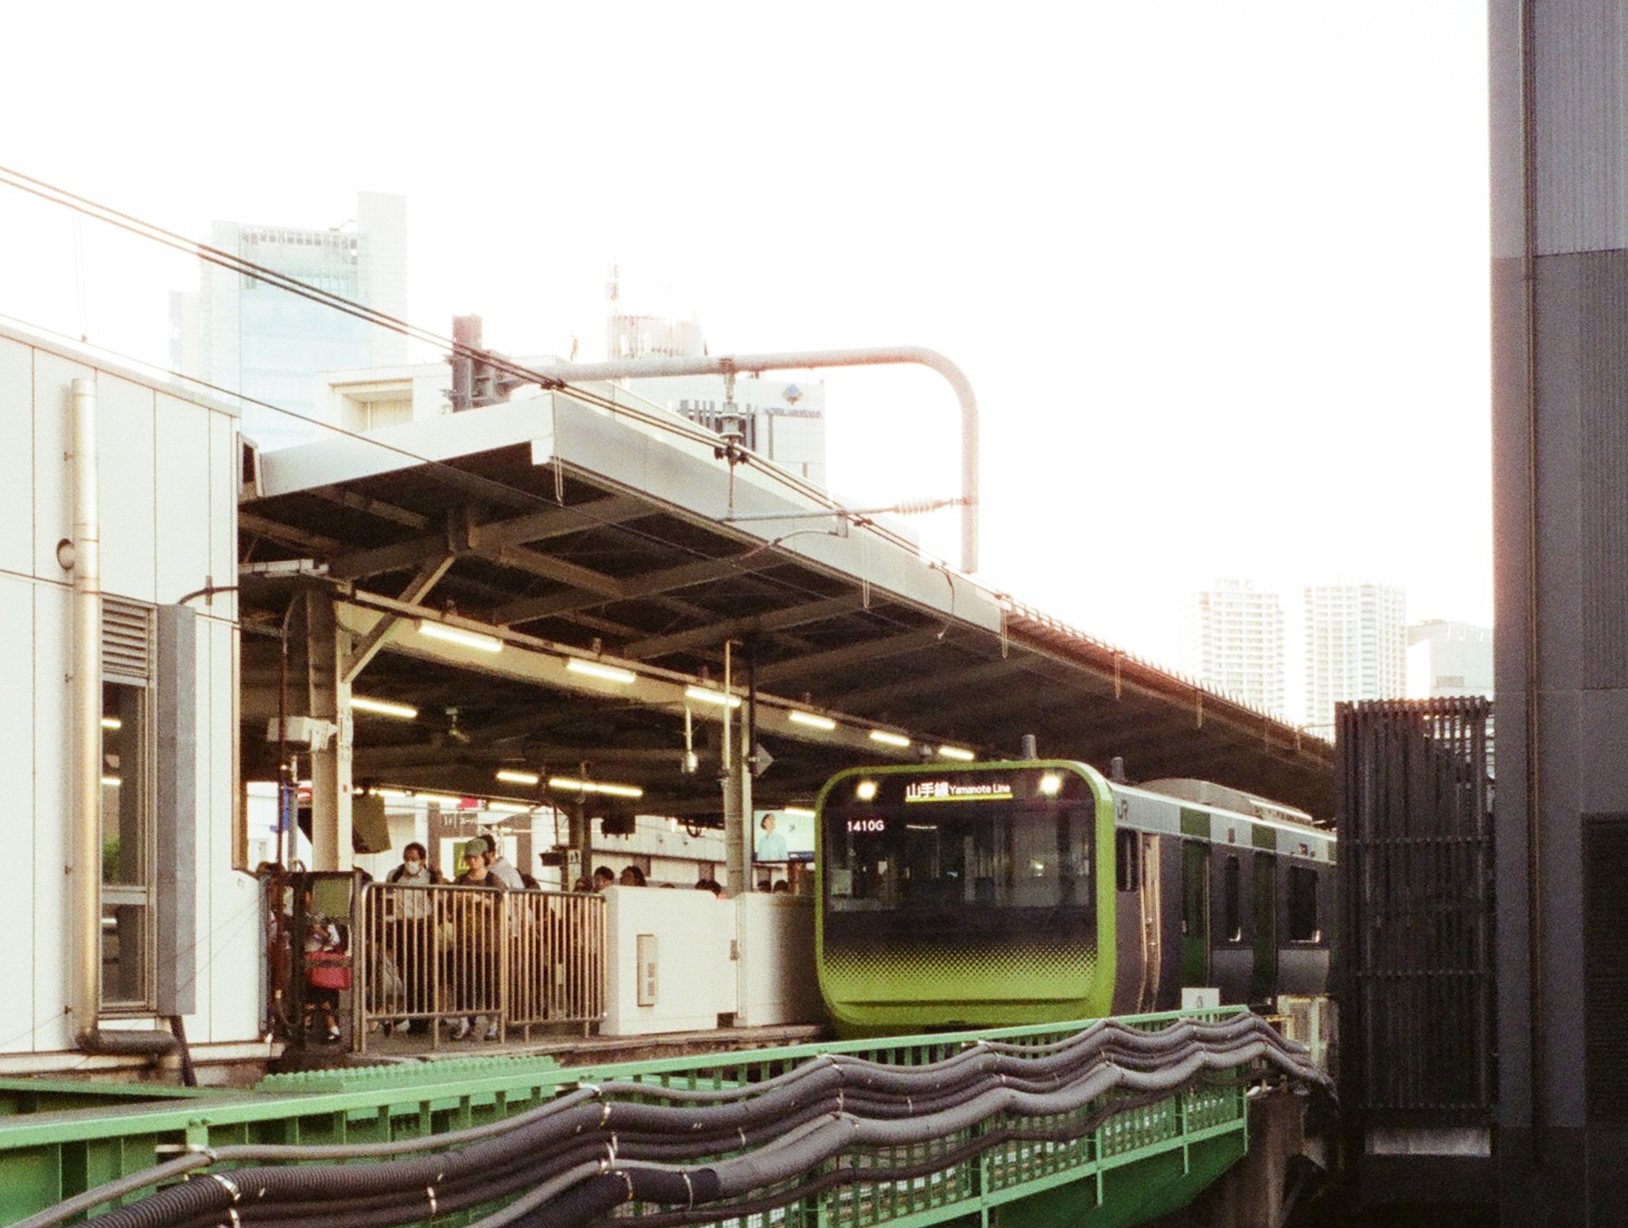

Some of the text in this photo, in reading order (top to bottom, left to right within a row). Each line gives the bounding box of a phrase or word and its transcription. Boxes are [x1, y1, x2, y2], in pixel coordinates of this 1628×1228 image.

[906, 782, 1011, 799] 山手線 Yamanote Line
[847, 819, 885, 832] 1410G
